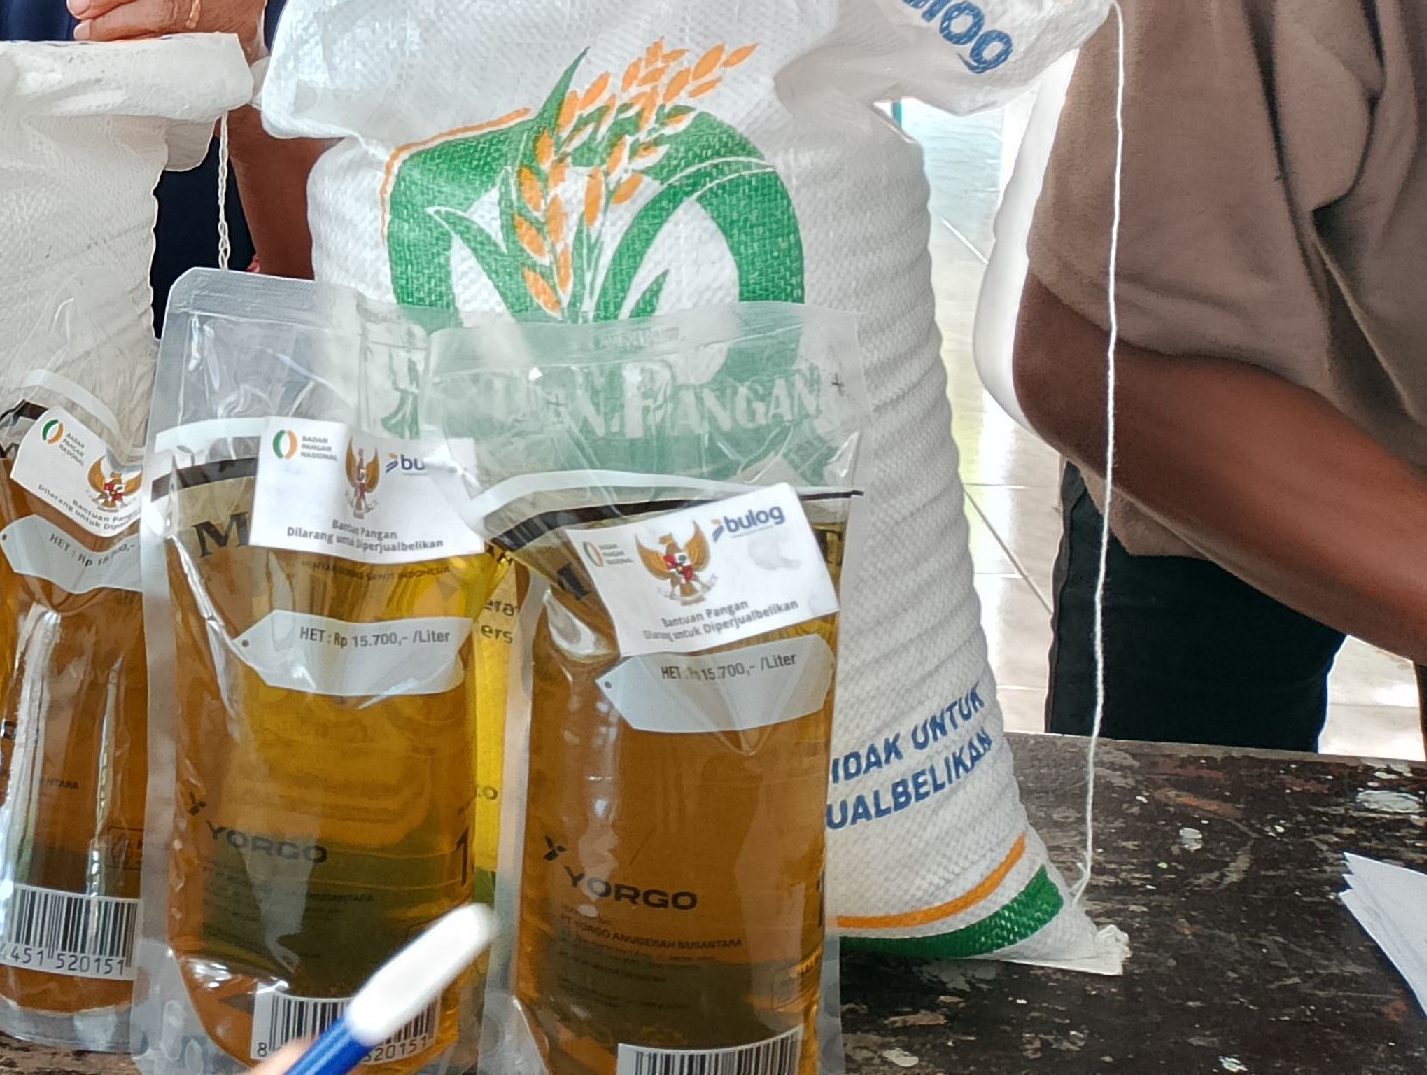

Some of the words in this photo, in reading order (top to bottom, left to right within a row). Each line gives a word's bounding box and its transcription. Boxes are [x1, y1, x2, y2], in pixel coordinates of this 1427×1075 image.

[724, 505, 785, 533] bulog
[49, 532, 71, 553] HET
[287, 526, 334, 544] Dilarang
[356, 538, 444, 555] Diperjualbelikan
[360, 526, 398, 541] Pangan
[661, 612, 704, 628] Bantuan
[705, 600, 750, 618] Pangan
[703, 599, 799, 635] Diperjualbelikan
[299, 625, 326, 643] HET
[333, 630, 349, 648] Rp
[412, 628, 451, 643] /Liter
[660, 665, 683, 680] HET
[759, 653, 798, 672] /Liter
[831, 733, 904, 784] IDAK
[912, 681, 985, 751] UNTUK
[826, 727, 993, 831] UALBELIKAN
[206, 820, 329, 864] YORGO
[564, 866, 698, 911] YORGO
[54, 951, 125, 975] 520151
